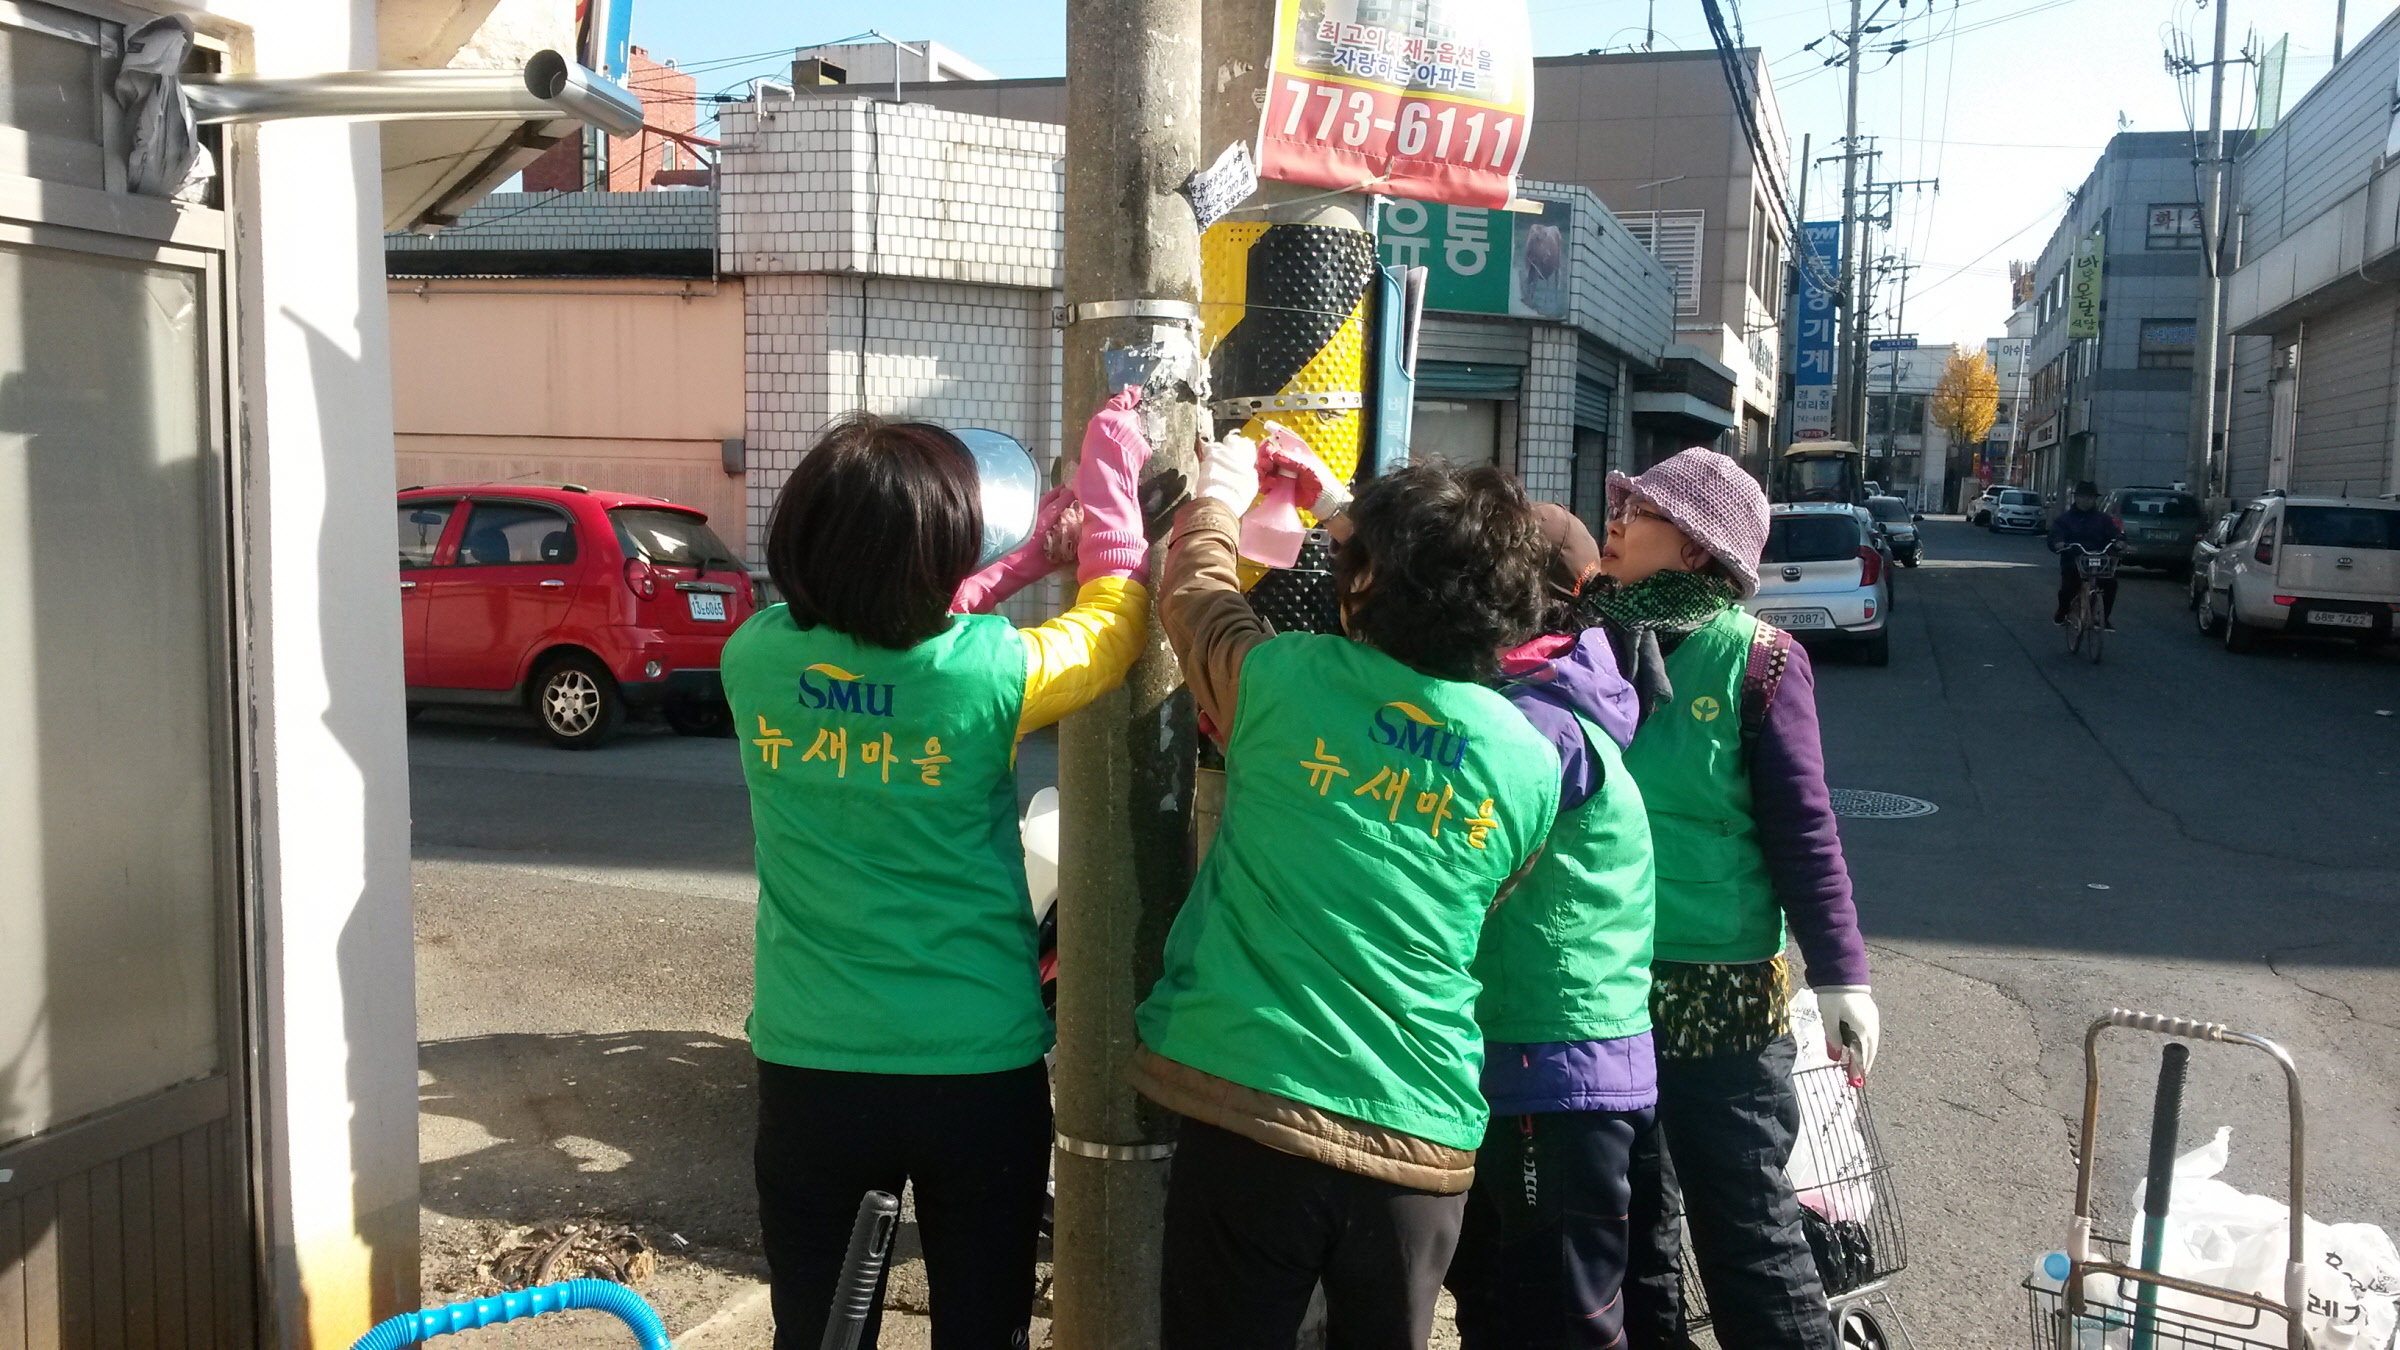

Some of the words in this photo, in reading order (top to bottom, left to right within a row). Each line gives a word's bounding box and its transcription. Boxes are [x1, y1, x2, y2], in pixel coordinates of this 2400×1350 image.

[1333, 47, 1411, 82] 자랑하는
[1417, 64, 1478, 89] 아파트
[1283, 79, 1514, 168] 773-6111
[1792, 614, 1819, 624] 2087
[2339, 614, 2366, 626] 7422
[798, 669, 896, 718] SMU
[1367, 705, 1469, 771] SMU
